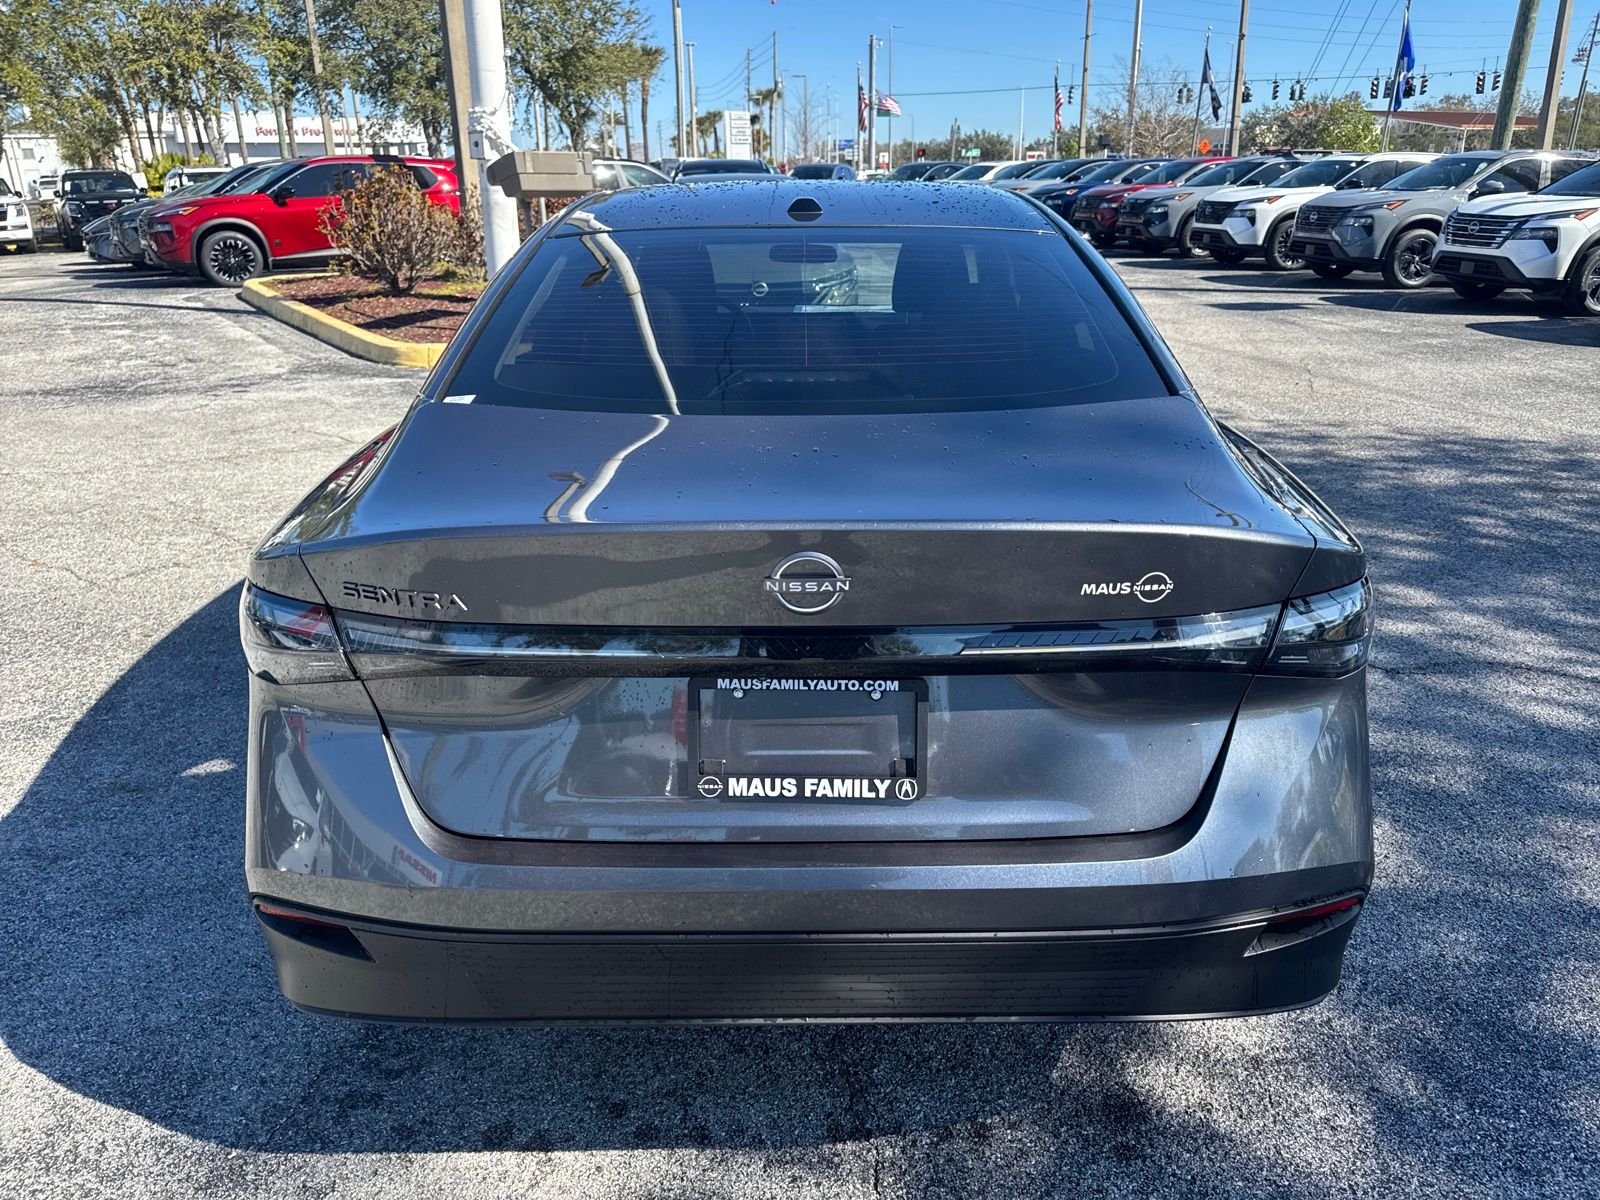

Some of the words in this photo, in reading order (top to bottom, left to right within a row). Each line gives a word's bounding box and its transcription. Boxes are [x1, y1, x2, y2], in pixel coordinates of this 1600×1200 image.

[765, 580, 850, 592] NISSAN
[1080, 582, 1132, 595] MAUS
[1132, 583, 1174, 592] NISSAN
[342, 581, 468, 611] SENTRA
[716, 678, 899, 692] MAUSFAMILYAUTO.COM
[728, 777, 798, 797] MAUS
[804, 778, 892, 799] FAMILY
